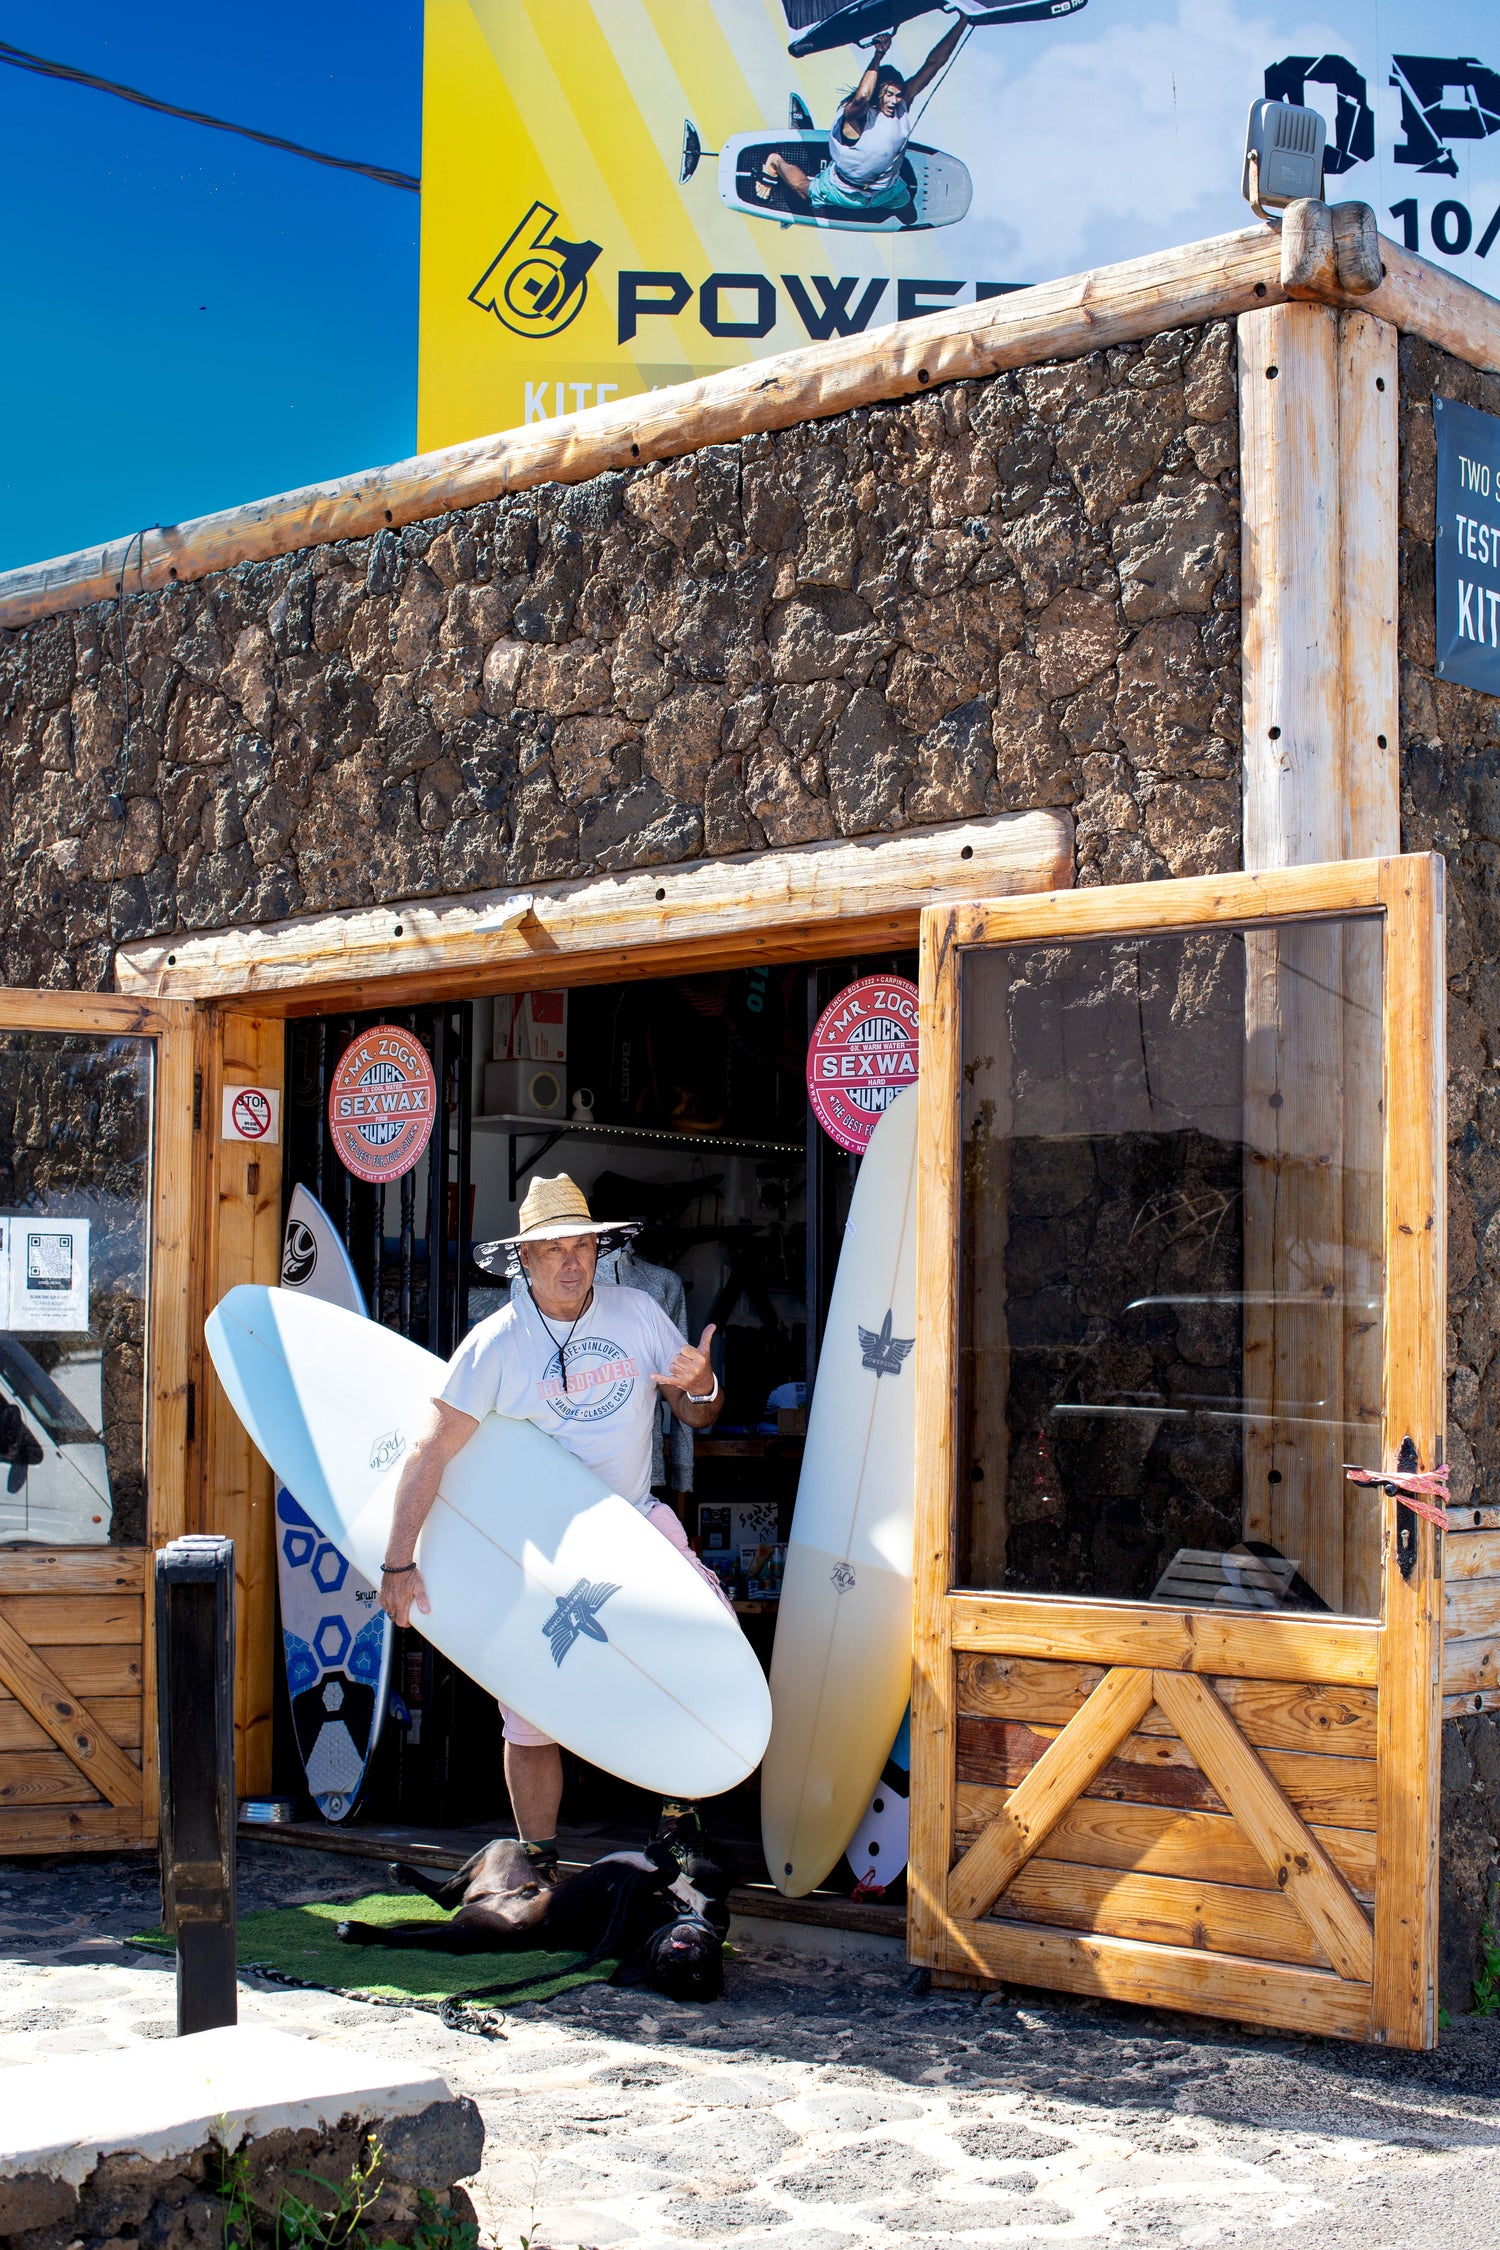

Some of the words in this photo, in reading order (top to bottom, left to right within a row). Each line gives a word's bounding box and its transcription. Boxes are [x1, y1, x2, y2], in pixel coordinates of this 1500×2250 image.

[618, 270, 1037, 346] POWE
[1458, 455, 1491, 498] TWO
[822, 1009, 834, 1022] WAX
[831, 995, 844, 1008] INC.
[847, 984, 859, 994] BOX
[861, 978, 875, 986] 1222
[873, 990, 919, 1028] ZOGS
[848, 1018, 908, 1042] QUICK
[378, 1039, 418, 1071] ZOGS
[862, 1043, 882, 1051] WARM
[883, 1042, 906, 1050] WATER
[359, 1063, 406, 1087] QUICK
[822, 1052, 919, 1078] SEXWA
[237, 1094, 267, 1108] STOP
[340, 1090, 425, 1117] SEXWAX
[371, 1085, 385, 1093] COOL
[385, 1083, 403, 1092] WATER
[808, 1082, 850, 1147] WWW.SEXWAX.COM
[830, 1097, 846, 1119] THE
[842, 1113, 864, 1135] BEST
[357, 1122, 405, 1144] HUMPS
[346, 1134, 358, 1153] THE
[355, 1147, 372, 1165] BEST
[386, 1148, 404, 1165] YOUR
[581, 1341, 618, 1359] VANLOVE
[863, 1356, 900, 1369] POWERZONE
[543, 1361, 633, 1397] BUSDRIVER
[555, 1399, 580, 1417] VANONE
[583, 1401, 614, 1418] CLASSIC
[613, 1382, 629, 1402] CARS
[548, 1582, 588, 1635] POWERZONE
